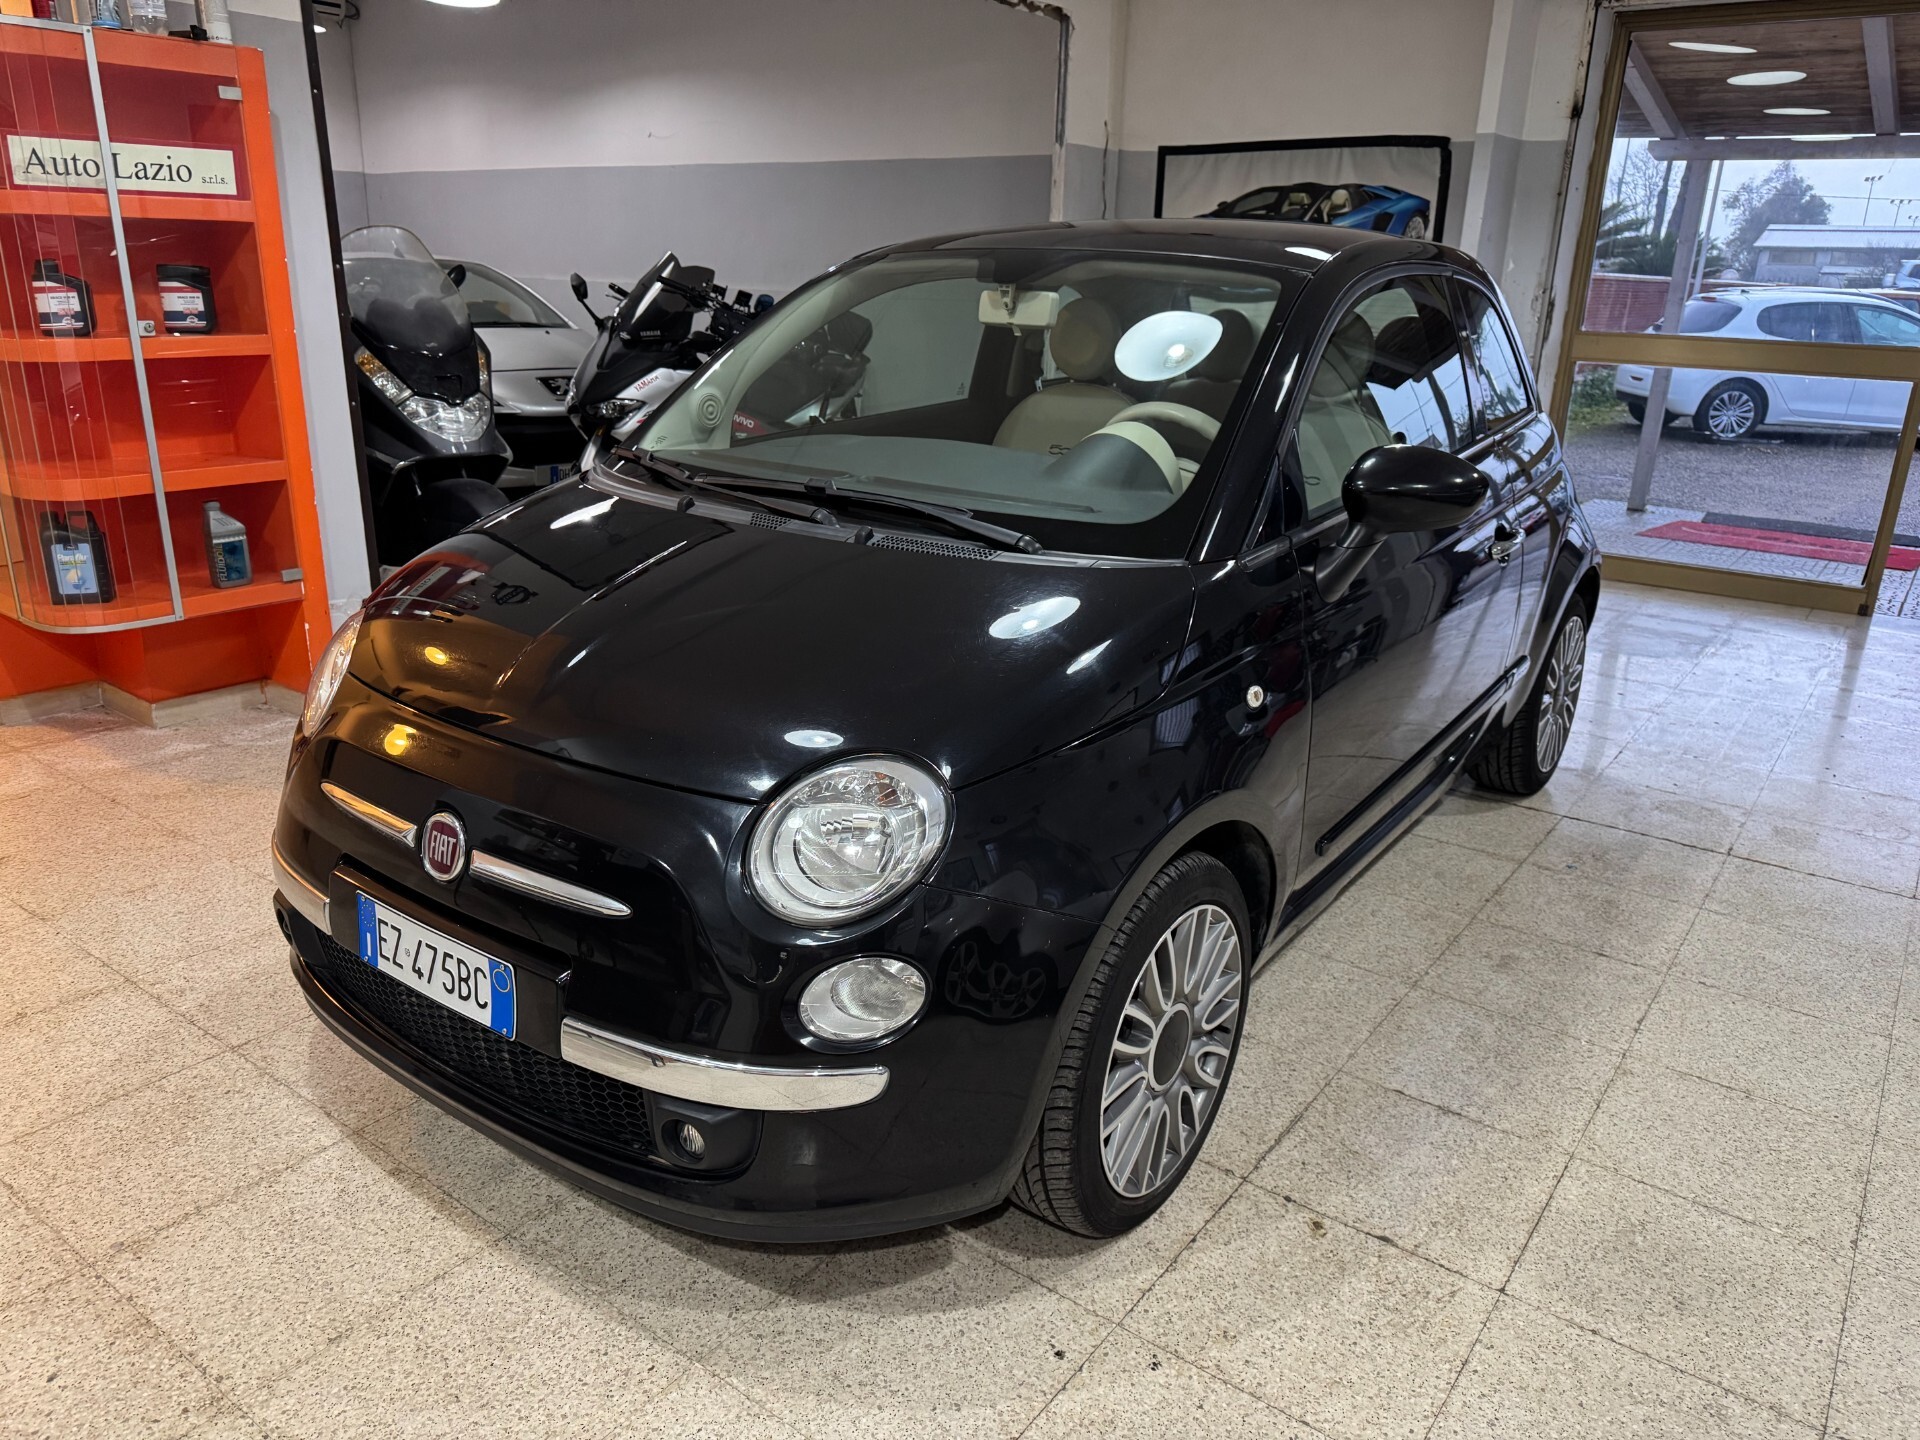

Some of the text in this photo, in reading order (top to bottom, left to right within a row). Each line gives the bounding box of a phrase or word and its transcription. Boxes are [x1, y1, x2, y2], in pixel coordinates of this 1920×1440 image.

[22, 147, 229, 185] Auto Lazio s.r.l.s.
[639, 329, 661, 337] YAMAHA
[429, 830, 457, 866] FIAT
[377, 917, 489, 1010] EZ 475BC
